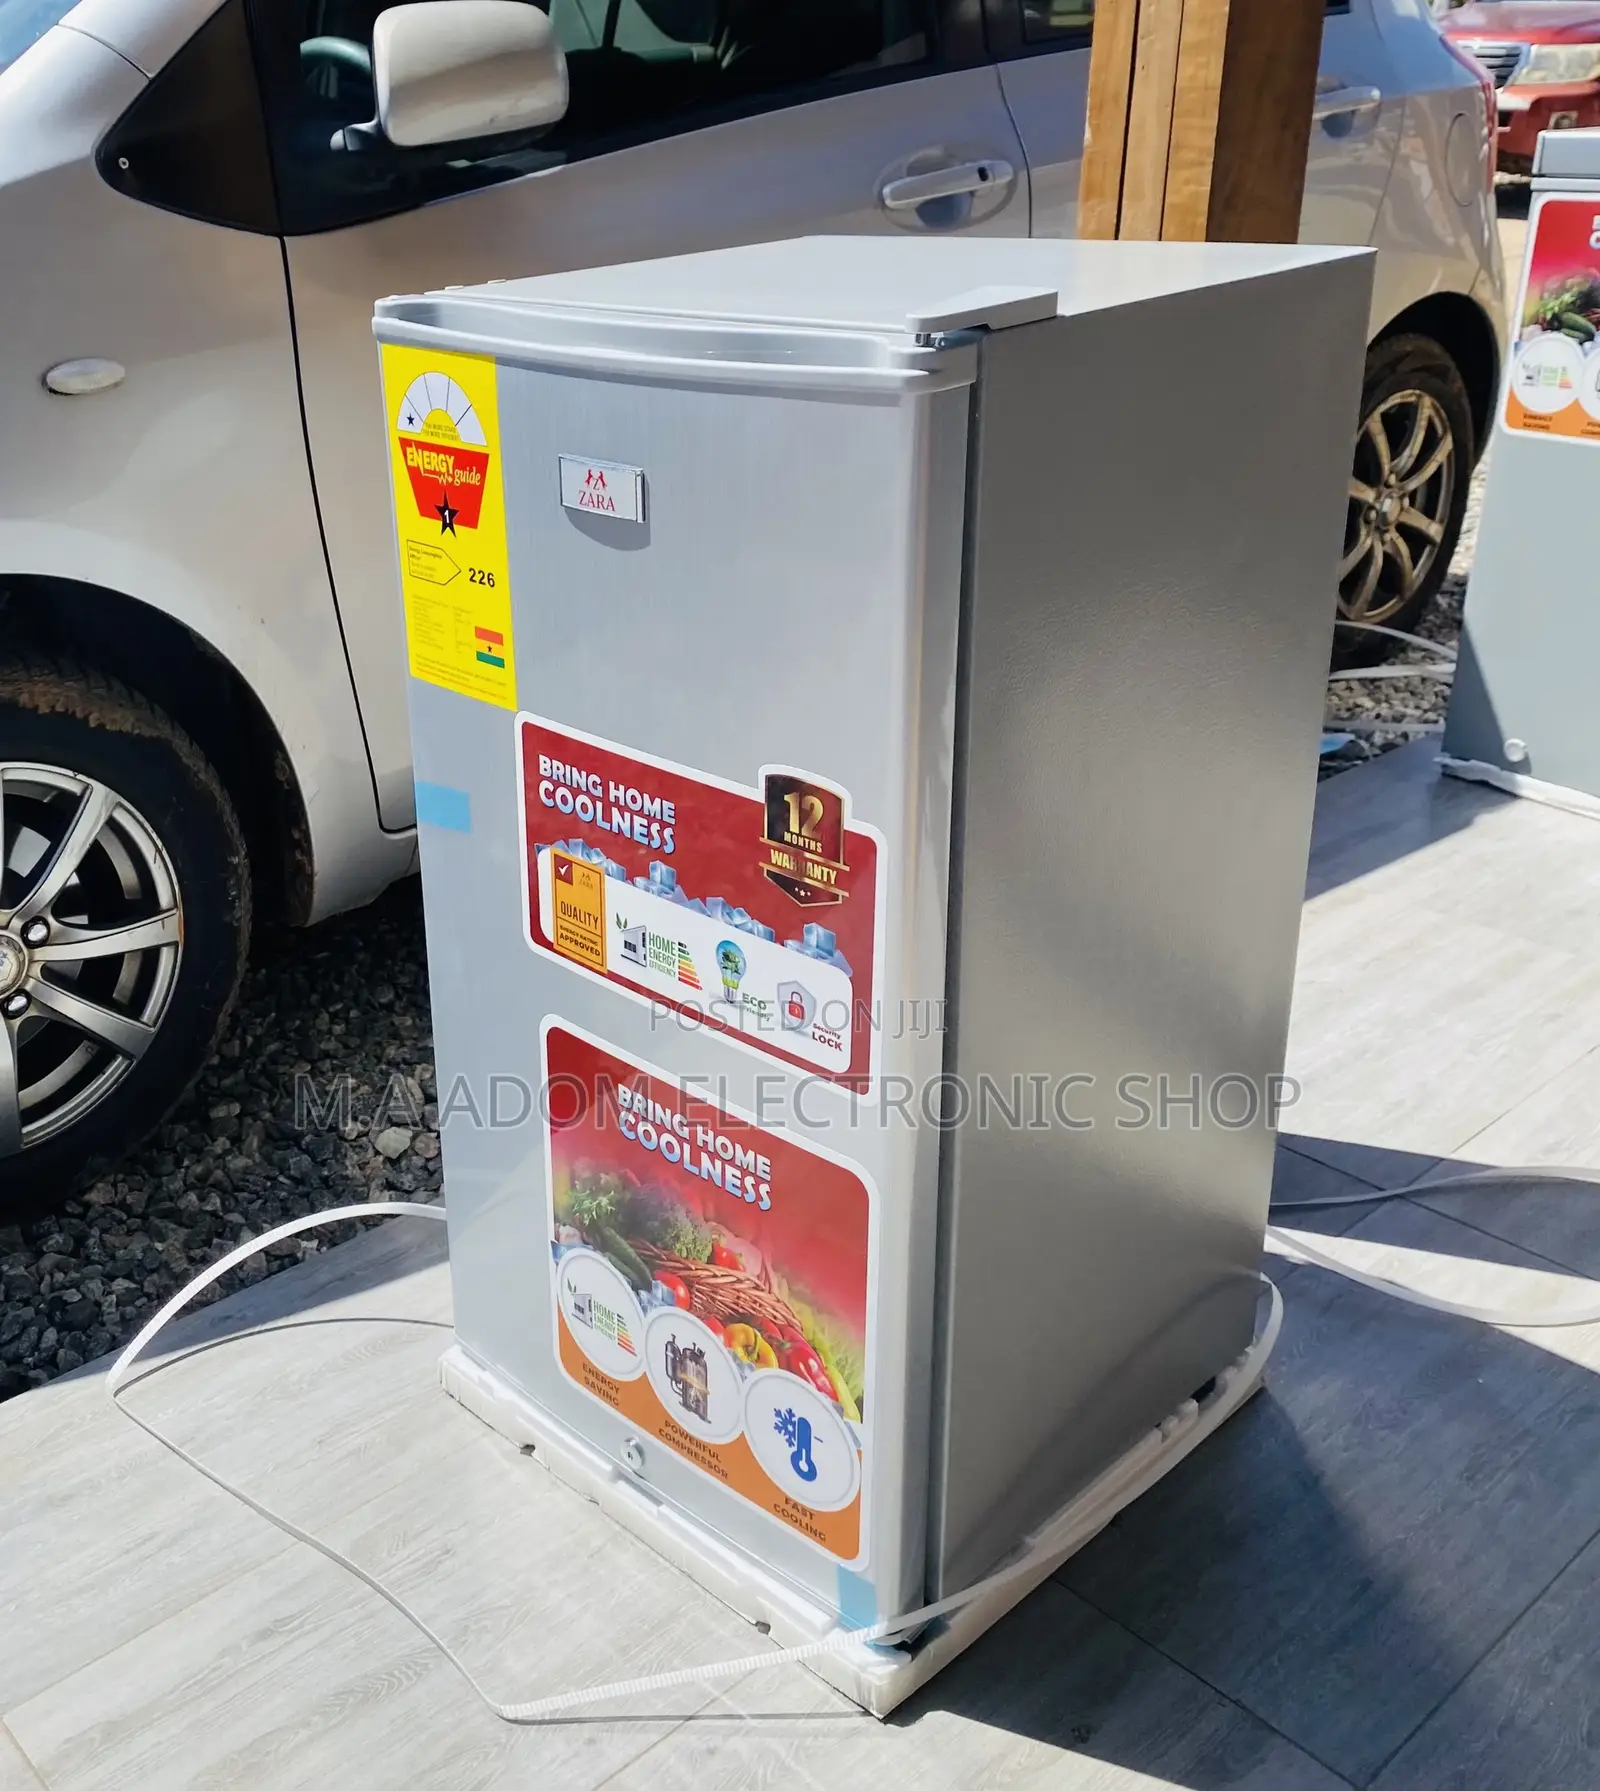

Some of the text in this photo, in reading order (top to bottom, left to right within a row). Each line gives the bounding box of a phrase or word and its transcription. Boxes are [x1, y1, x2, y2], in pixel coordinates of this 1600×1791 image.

[406, 442, 455, 475] ENERGY
[454, 466, 481, 486] guide
[579, 490, 615, 512] ZARA
[444, 509, 450, 524] 1
[468, 567, 495, 588] 226
[538, 754, 676, 825] BRING HOME
[538, 780, 675, 855] COOLNESS
[784, 792, 824, 838] 12
[784, 831, 822, 853] MONTHS
[560, 901, 599, 930] QUALITY
[559, 934, 600, 957] APPROVED
[649, 931, 677, 957] HOME
[649, 947, 677, 968] ENERGY
[742, 992, 767, 1010] ECO
[812, 1023, 841, 1040] Security
[812, 1031, 843, 1052] LOCK
[618, 1083, 772, 1182] BRING HOME
[618, 1111, 772, 1211] COOLNESS
[593, 1299, 616, 1325] HOME
[582, 1362, 620, 1395] ENERGY
[584, 1376, 619, 1406] SAVING
[658, 1428, 729, 1480] COMPRESSOR
[664, 1420, 722, 1464] POWERFUL
[784, 1497, 815, 1521] FAST
[773, 1503, 827, 1542] COOLING
